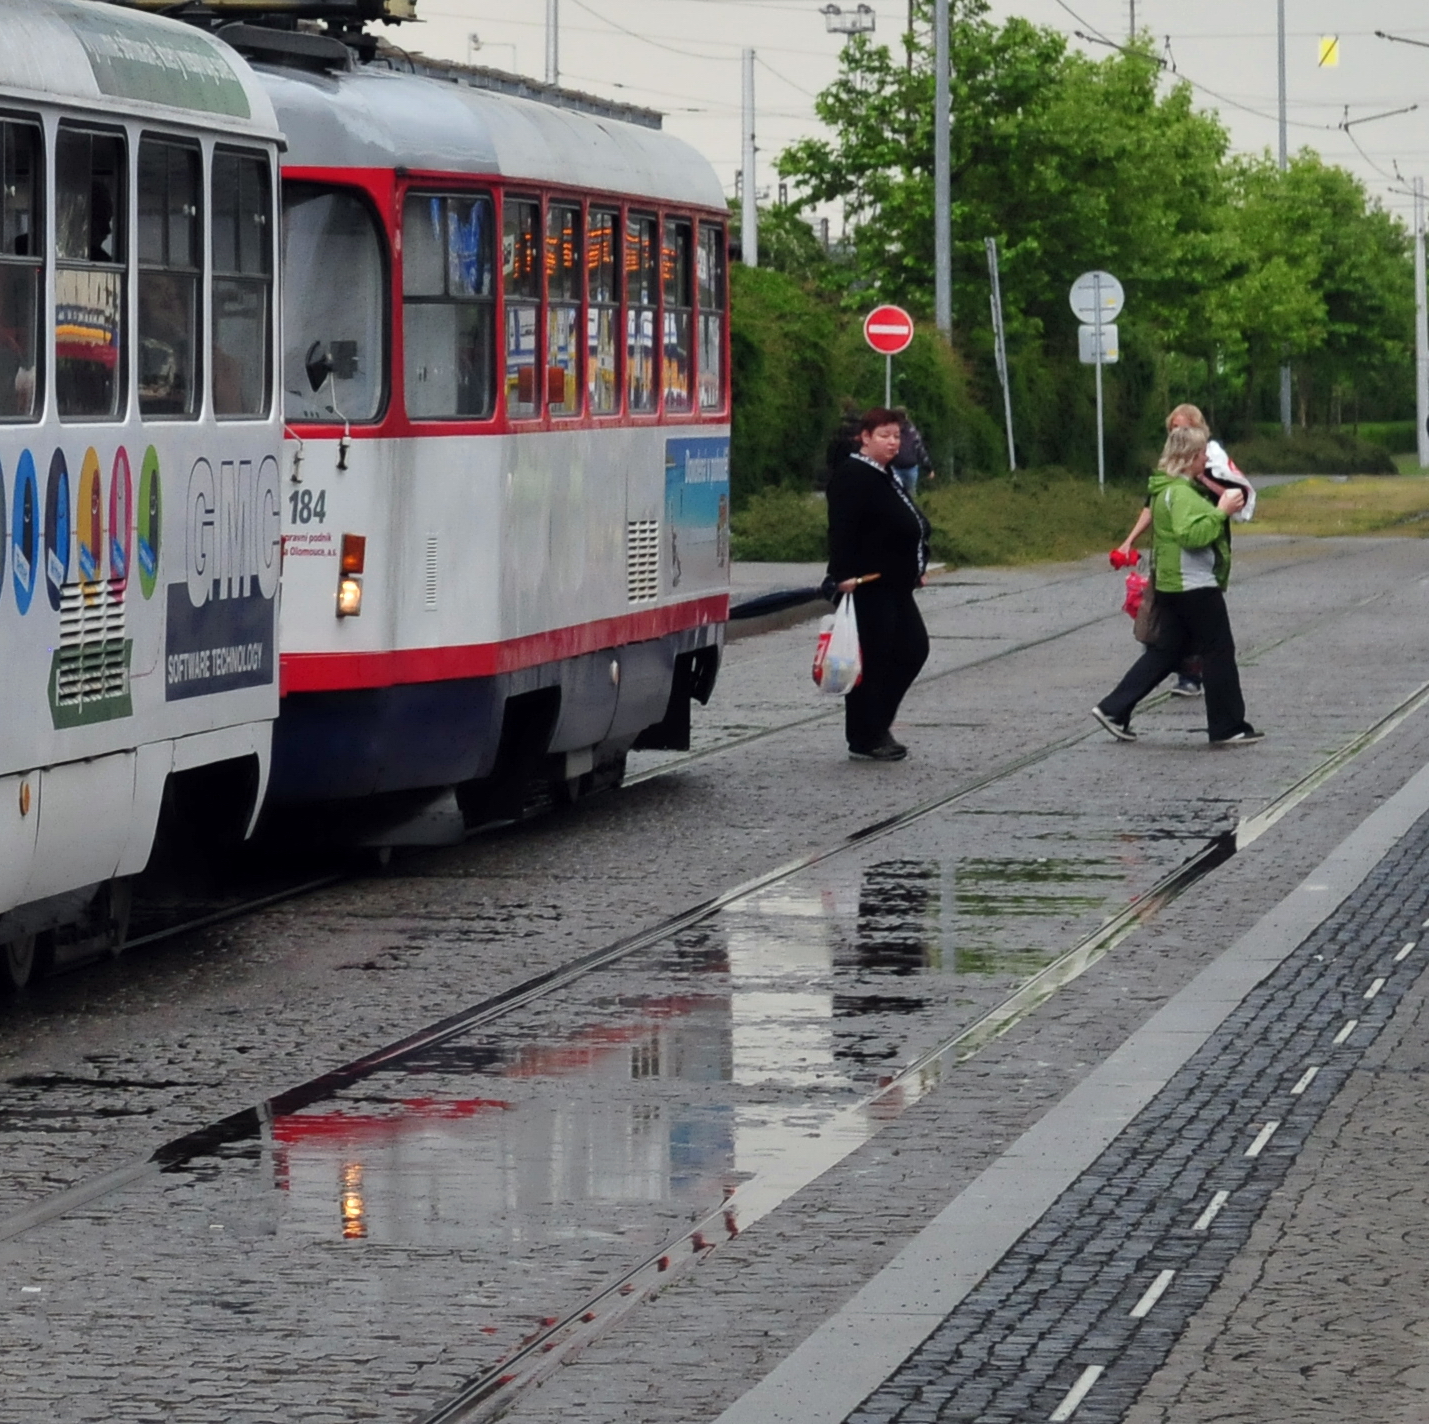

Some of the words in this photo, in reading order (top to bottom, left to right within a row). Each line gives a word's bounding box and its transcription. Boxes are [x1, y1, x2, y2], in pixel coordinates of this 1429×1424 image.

[288, 488, 327, 525] 184
[186, 454, 281, 608] GMC
[168, 649, 211, 685] SOFTWARE
[211, 641, 263, 678] TECHNOLOGY
